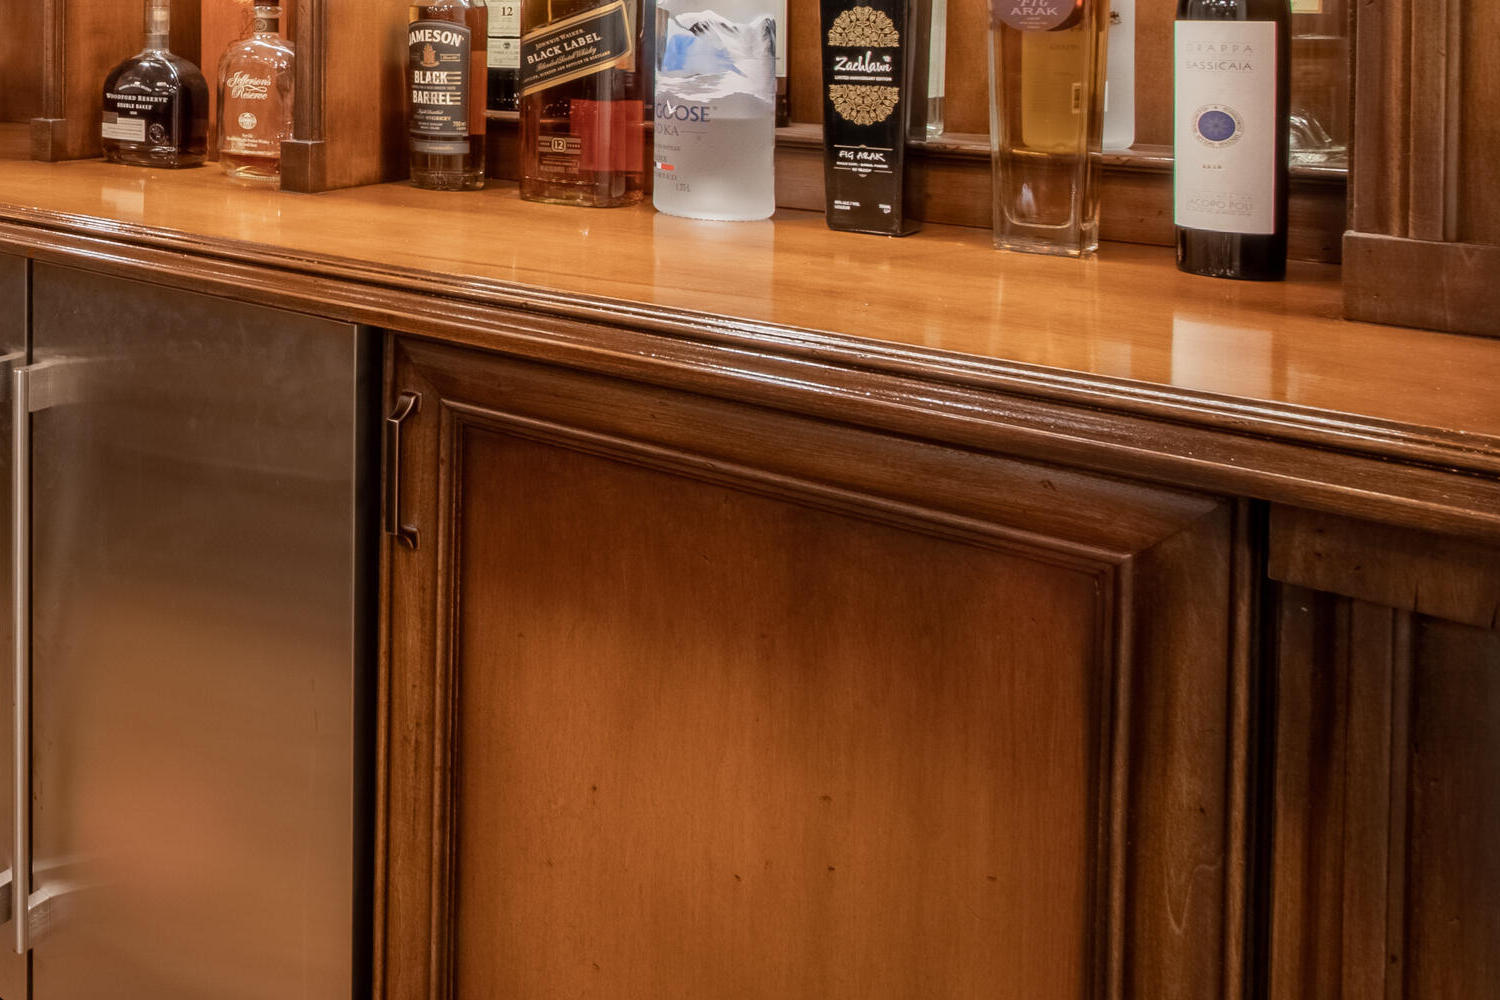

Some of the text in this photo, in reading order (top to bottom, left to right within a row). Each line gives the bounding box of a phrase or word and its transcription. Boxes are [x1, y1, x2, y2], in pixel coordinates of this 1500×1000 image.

[501, 6, 513, 17] 12
[1009, 7, 1059, 17] ARAK
[408, 28, 463, 47] JAMESON
[526, 31, 603, 65] BLACK LABEL
[834, 50, 893, 73] Zachlawi
[414, 70, 449, 85] BLACK
[412, 89, 453, 106] BARREL
[655, 102, 711, 122] GOOSE
[838, 150, 887, 163] FIG ARAK
